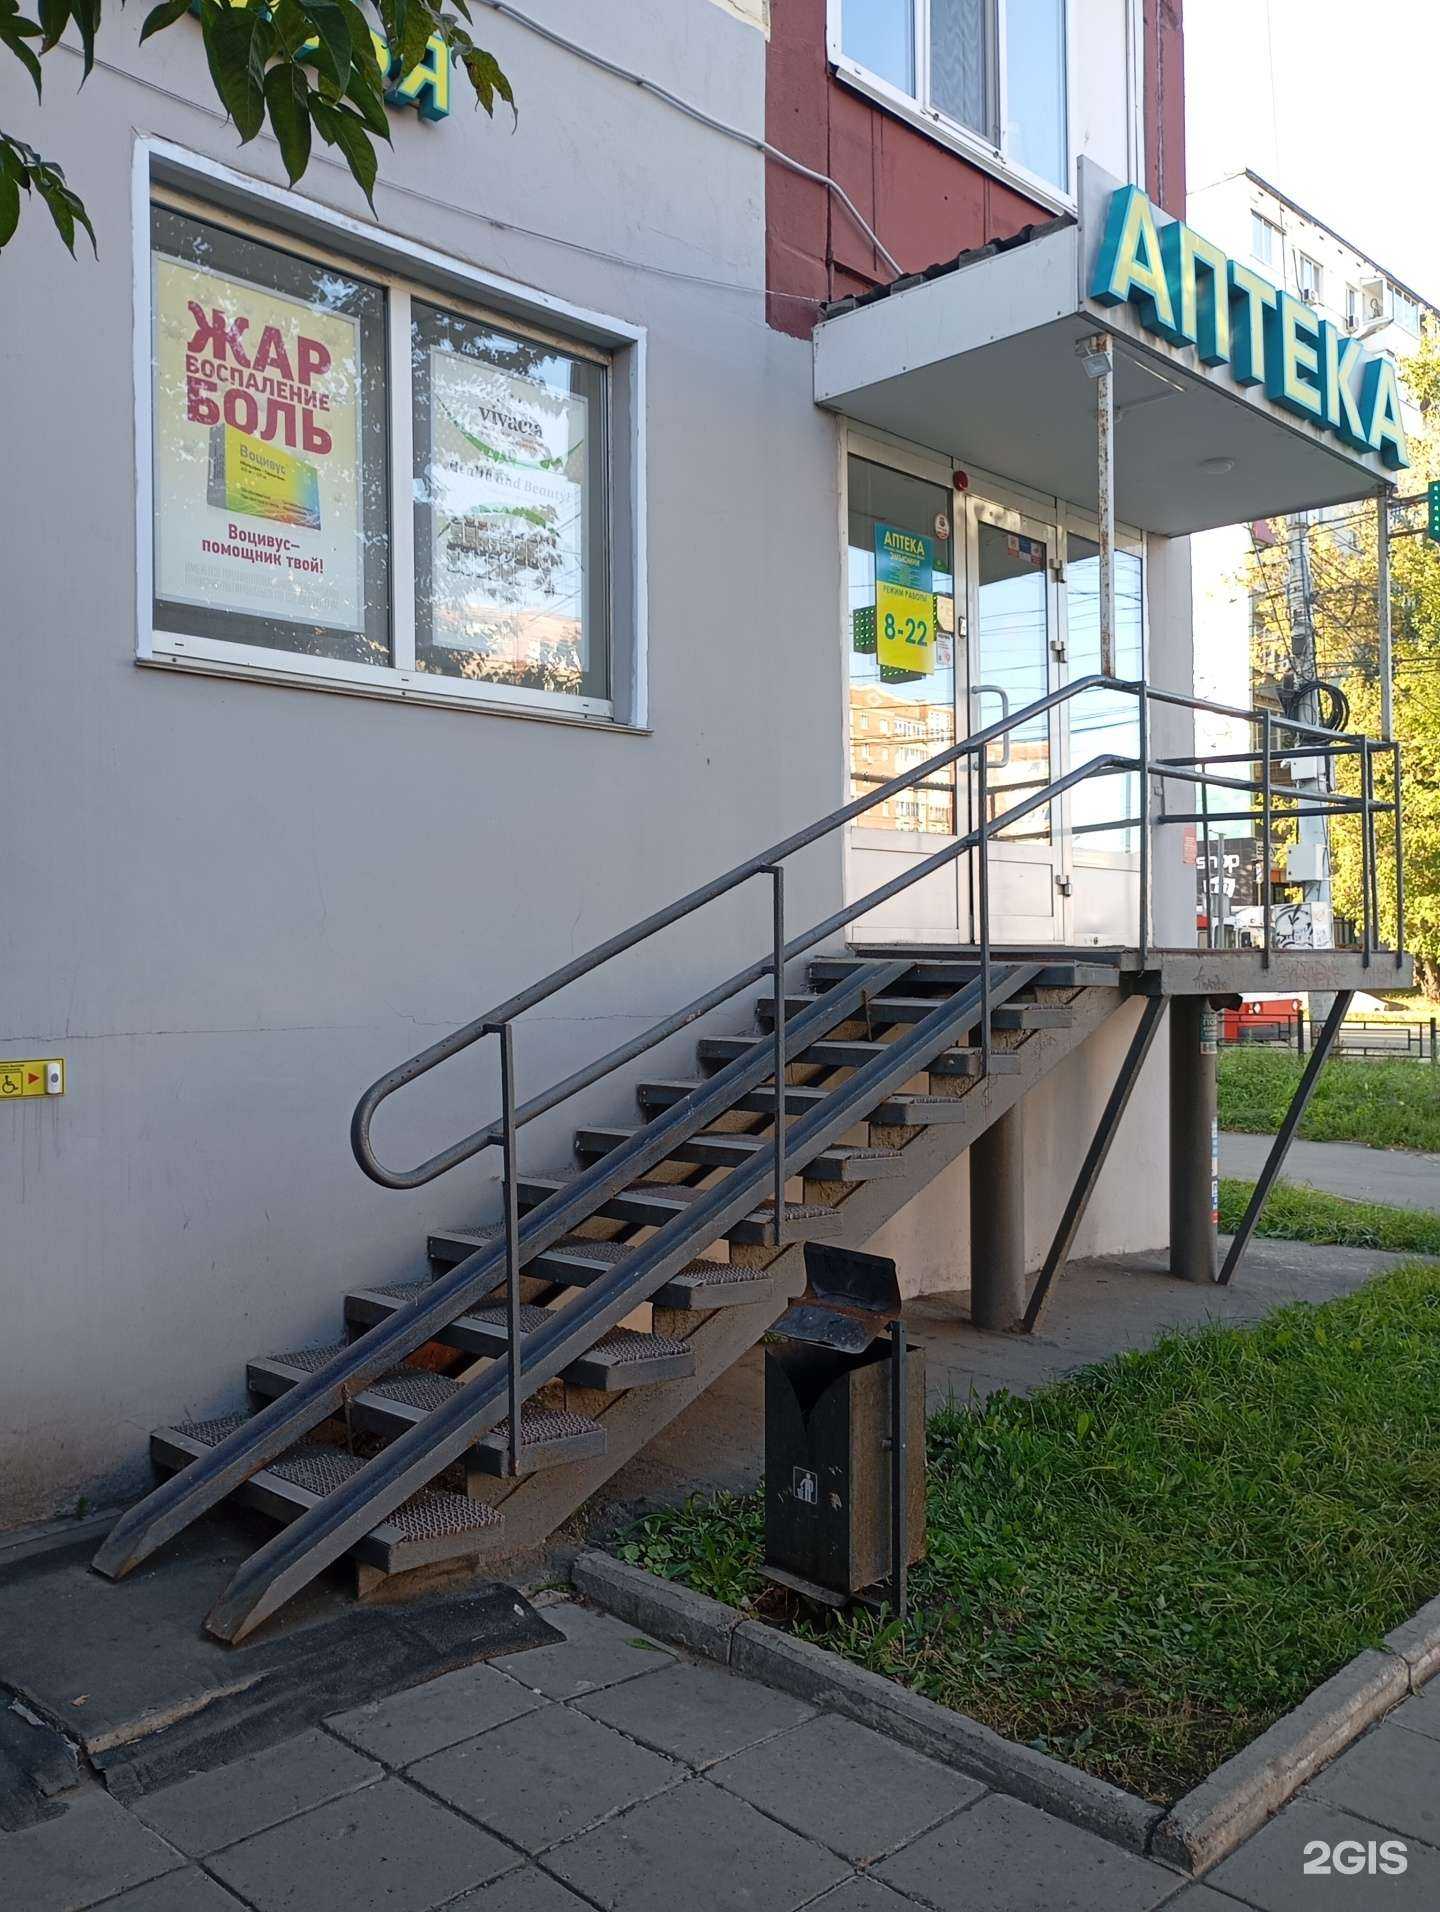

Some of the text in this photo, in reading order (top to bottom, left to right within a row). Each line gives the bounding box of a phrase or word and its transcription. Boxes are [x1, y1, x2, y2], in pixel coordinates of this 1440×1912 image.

[187, 300, 331, 386] ЖАР
[1091, 184, 1409, 471] АПТЕКА
[186, 354, 330, 412] ВОСПАЛЕНИЕ
[187, 376, 332, 454] БОЛЬ
[240, 444, 286, 475] Воцивус
[202, 539, 323, 574] помощник твой!
[883, 530, 925, 556] АПТЕКА
[885, 612, 927, 647] 8-22
